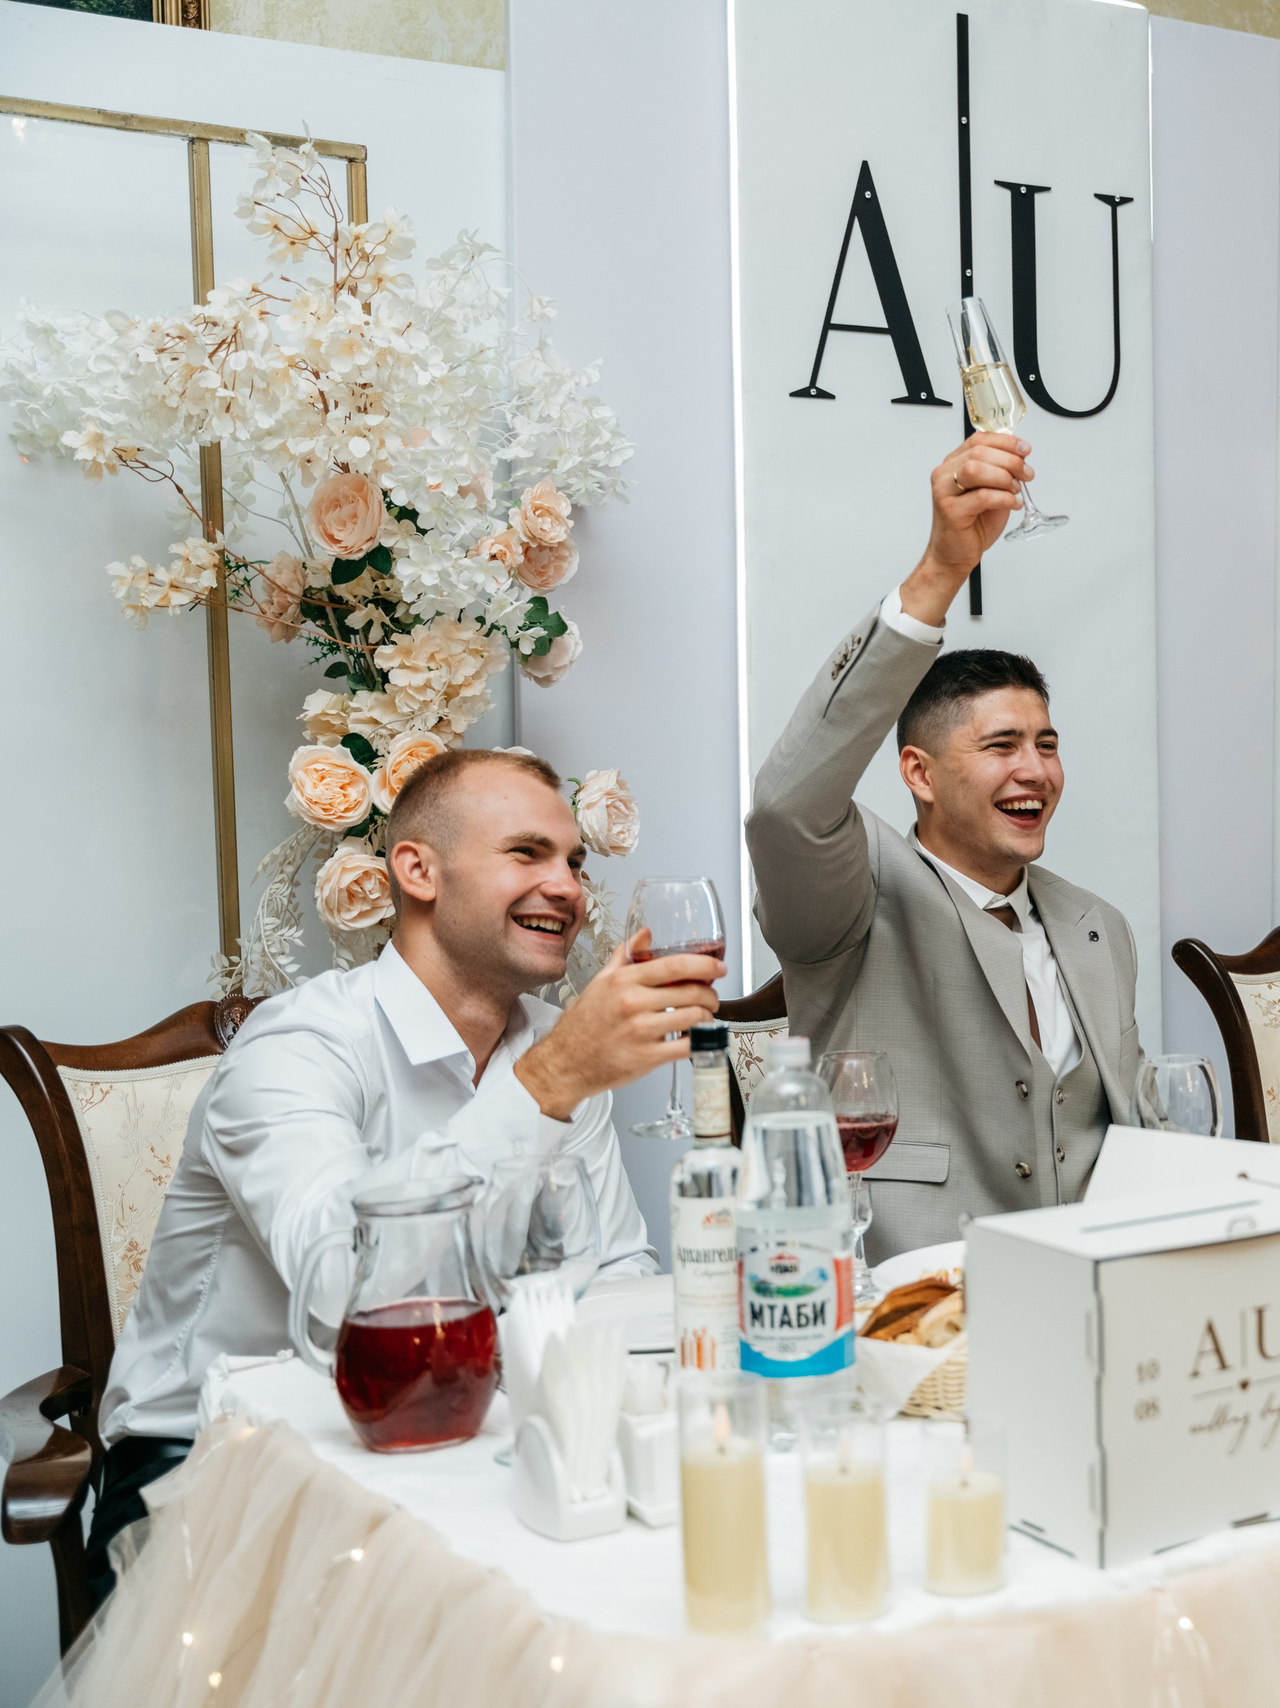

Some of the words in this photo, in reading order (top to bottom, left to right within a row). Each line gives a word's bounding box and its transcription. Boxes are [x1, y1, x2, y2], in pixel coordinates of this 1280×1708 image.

[749, 1300, 827, 1330] МТАБИ
[1135, 1359, 1161, 1385] 10
[1133, 1395, 1161, 1421] 08
